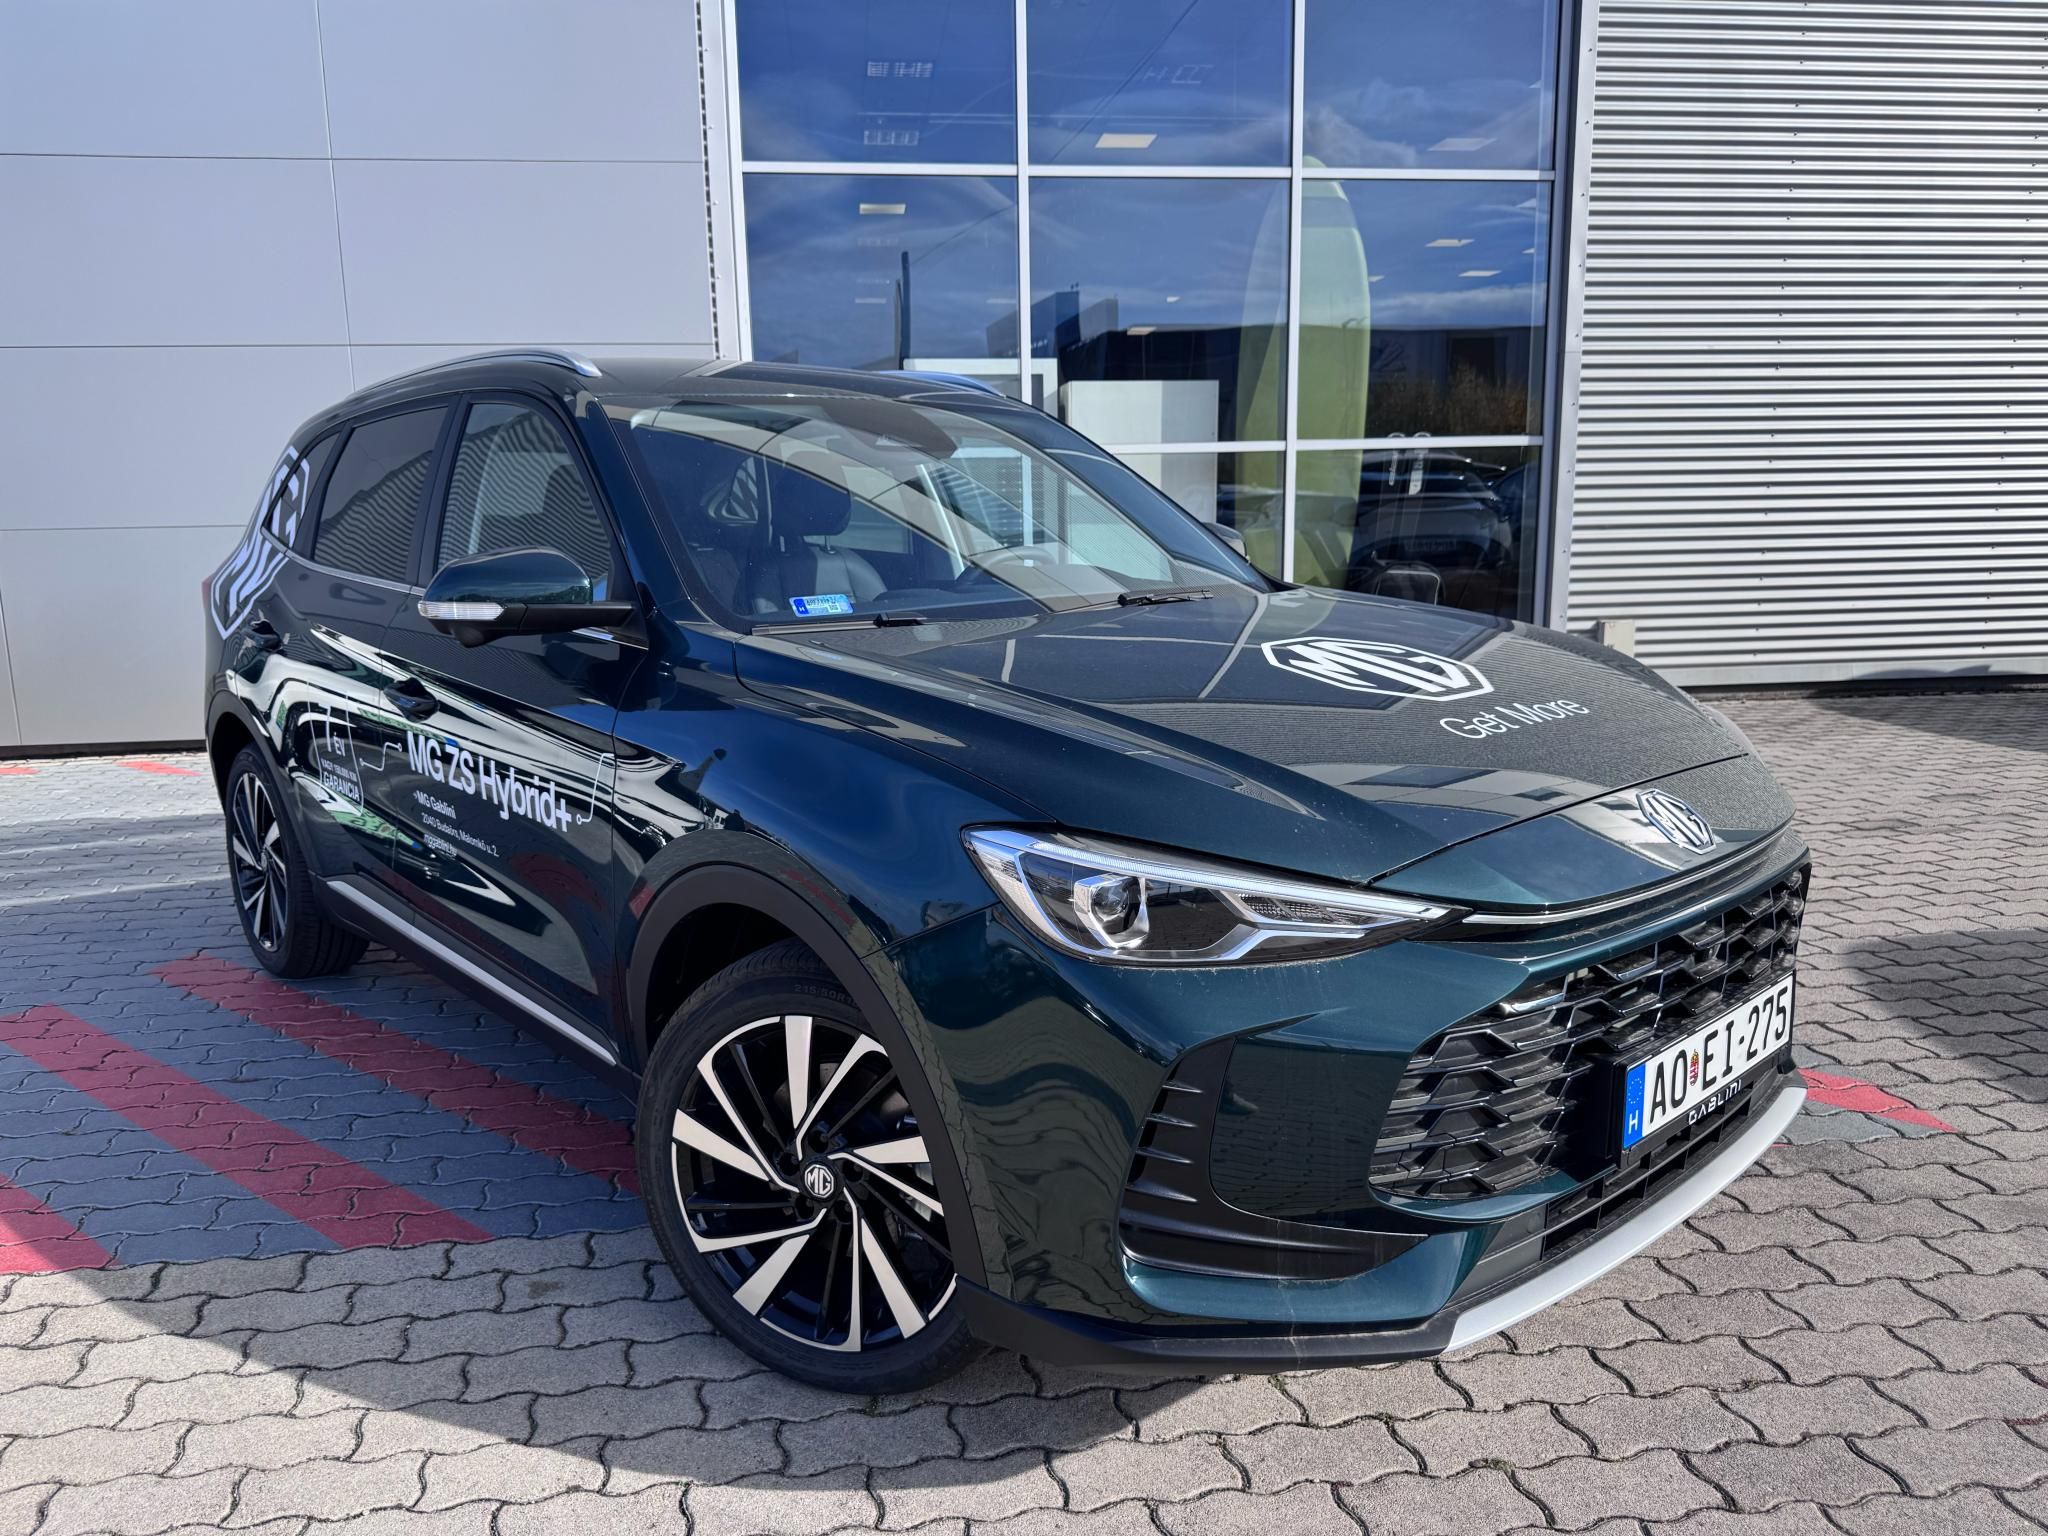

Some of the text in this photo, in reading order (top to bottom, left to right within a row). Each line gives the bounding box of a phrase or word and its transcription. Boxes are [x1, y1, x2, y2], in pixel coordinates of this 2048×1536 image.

[1287, 640, 1473, 693] MG
[1439, 696, 1590, 741] Get More
[333, 731, 346, 757] ÉV
[323, 771, 361, 802] GARANCIA
[407, 731, 572, 832] MG ZS Hybrid+
[416, 790, 457, 819] MG Gablini
[1645, 793, 1713, 851] MG
[1649, 1049, 1688, 1125] AO
[1688, 1079, 1742, 1126] GABLINI
[1628, 1109, 1639, 1135] H
[806, 1168, 834, 1195] MG
